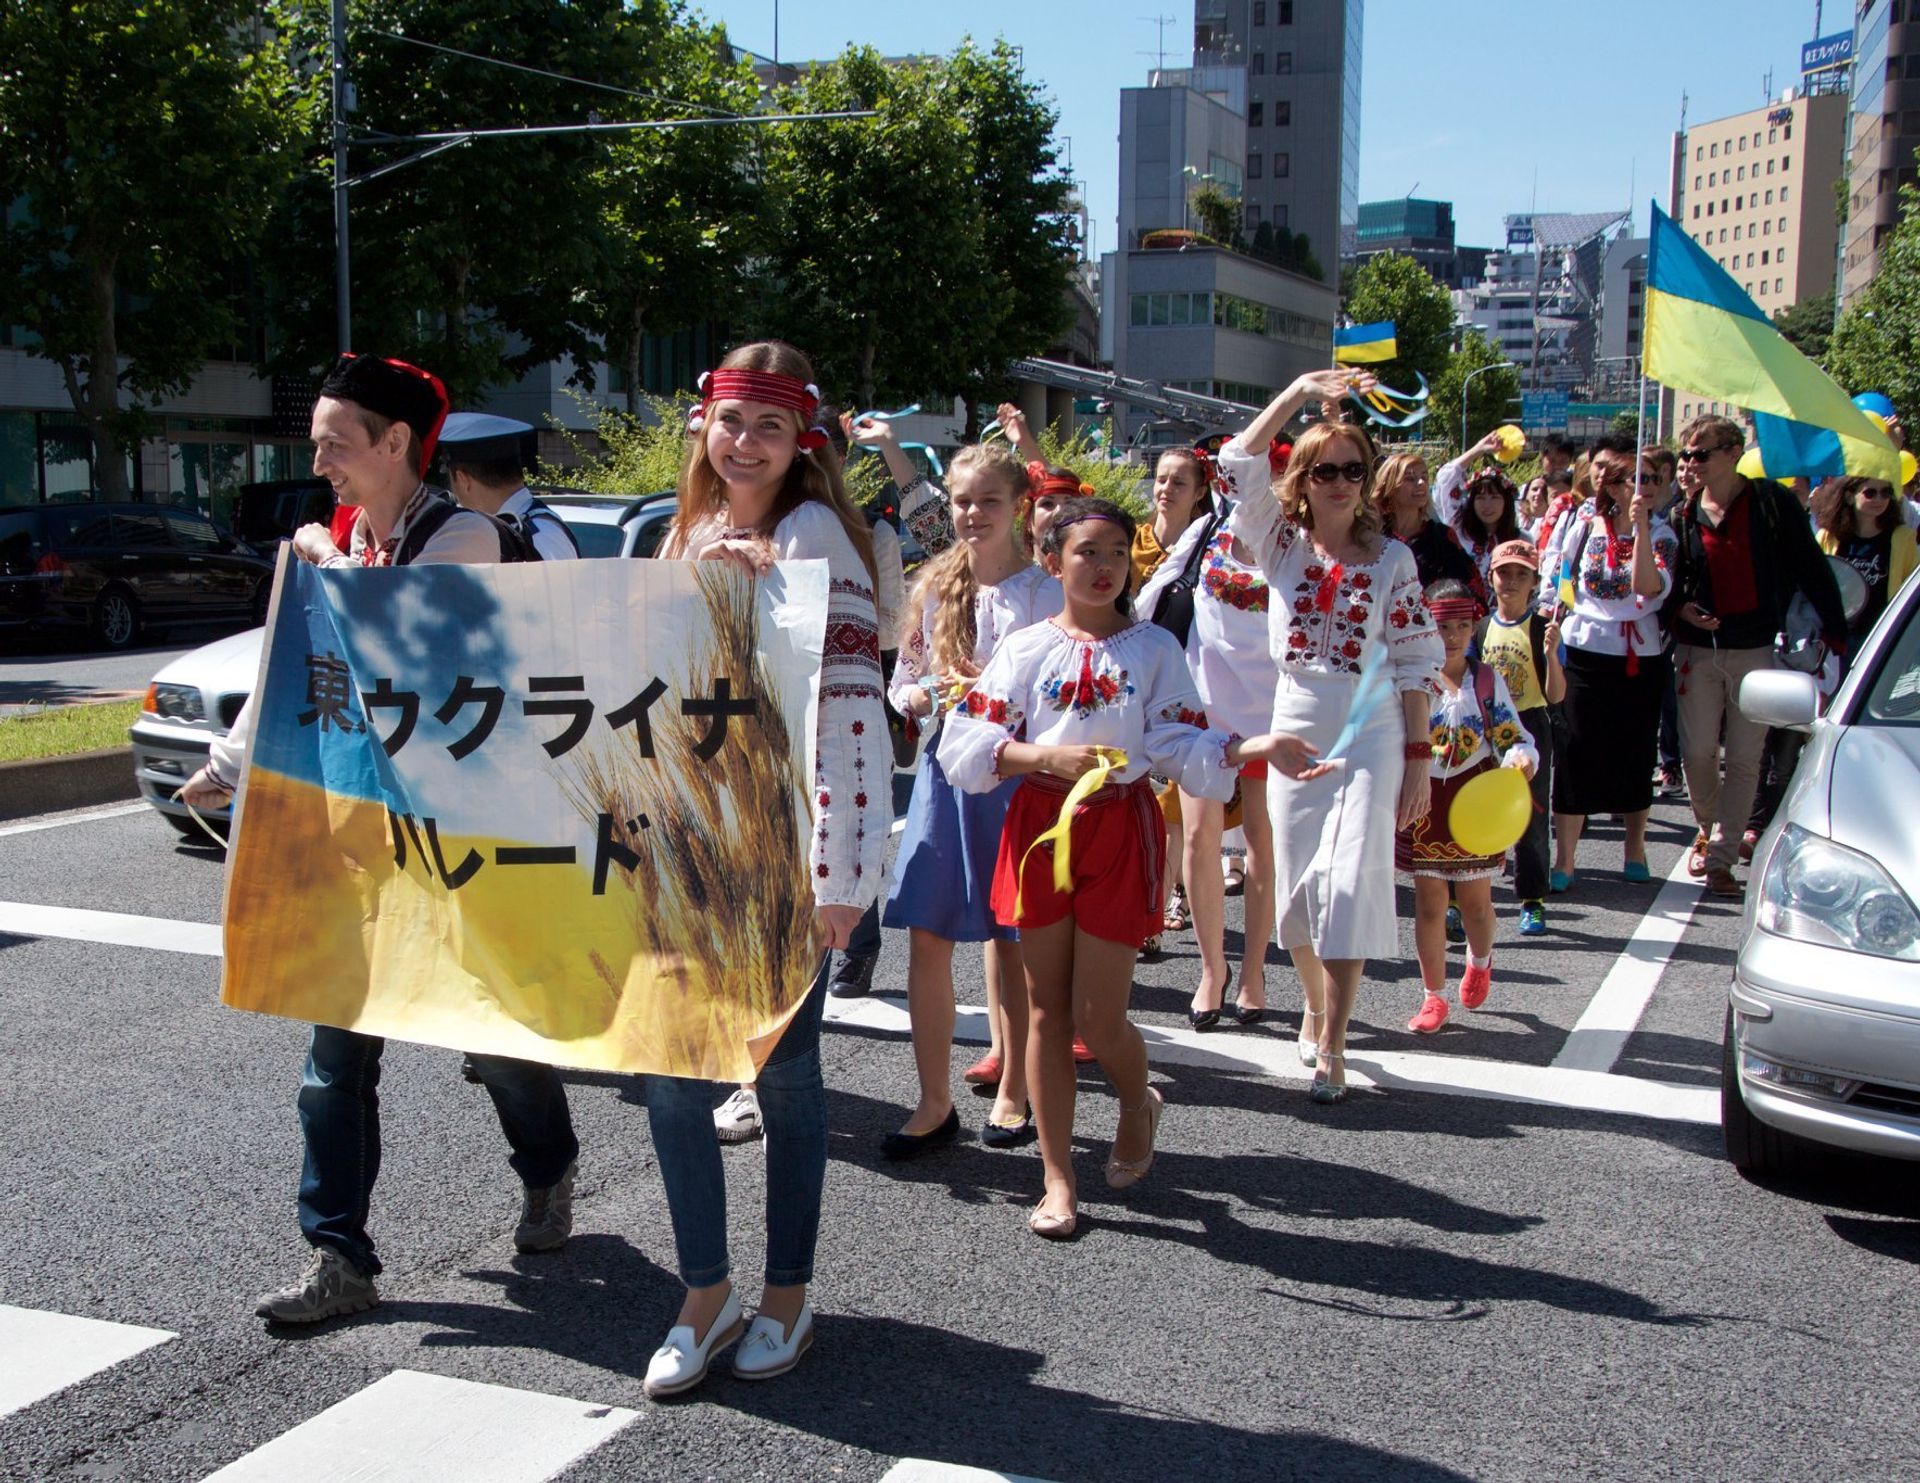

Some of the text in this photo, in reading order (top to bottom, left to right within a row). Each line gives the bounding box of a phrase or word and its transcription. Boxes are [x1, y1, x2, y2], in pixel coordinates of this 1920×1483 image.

[298, 650, 756, 763] 東ウクライナ
